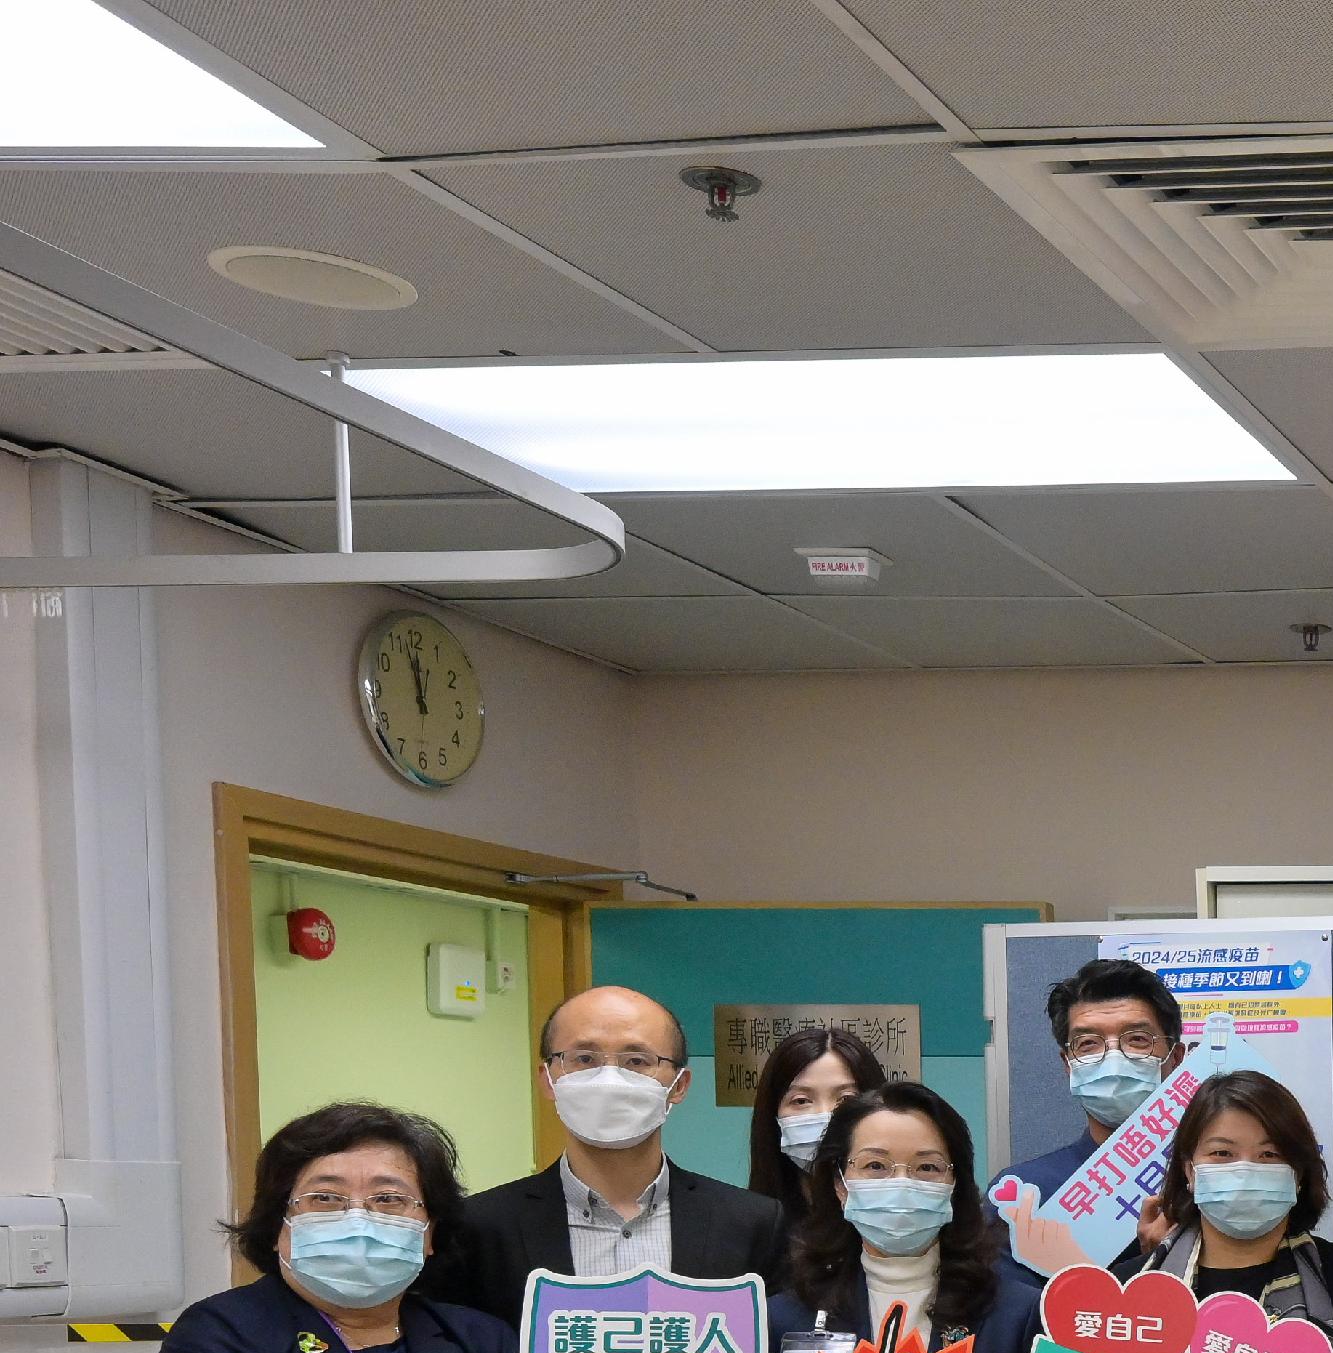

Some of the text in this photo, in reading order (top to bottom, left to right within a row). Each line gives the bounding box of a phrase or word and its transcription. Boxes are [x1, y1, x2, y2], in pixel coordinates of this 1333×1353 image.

[408, 629, 423, 650] 12
[377, 652, 391, 672] 10
[447, 670, 457, 689] 2
[455, 701, 464, 720] 3
[397, 738, 405, 754] 7
[452, 730, 460, 748] 4
[418, 752, 428, 769] 6
[439, 748, 447, 766] 5
[1132, 947, 1260, 965] 2024/25流感疫苗
[727, 1017, 907, 1056] 專職醫診所
[728, 1064, 757, 1090] Allied
[1058, 1070, 1201, 1222] 早打唔好遲
[1074, 1310, 1164, 1344] 愛自己
